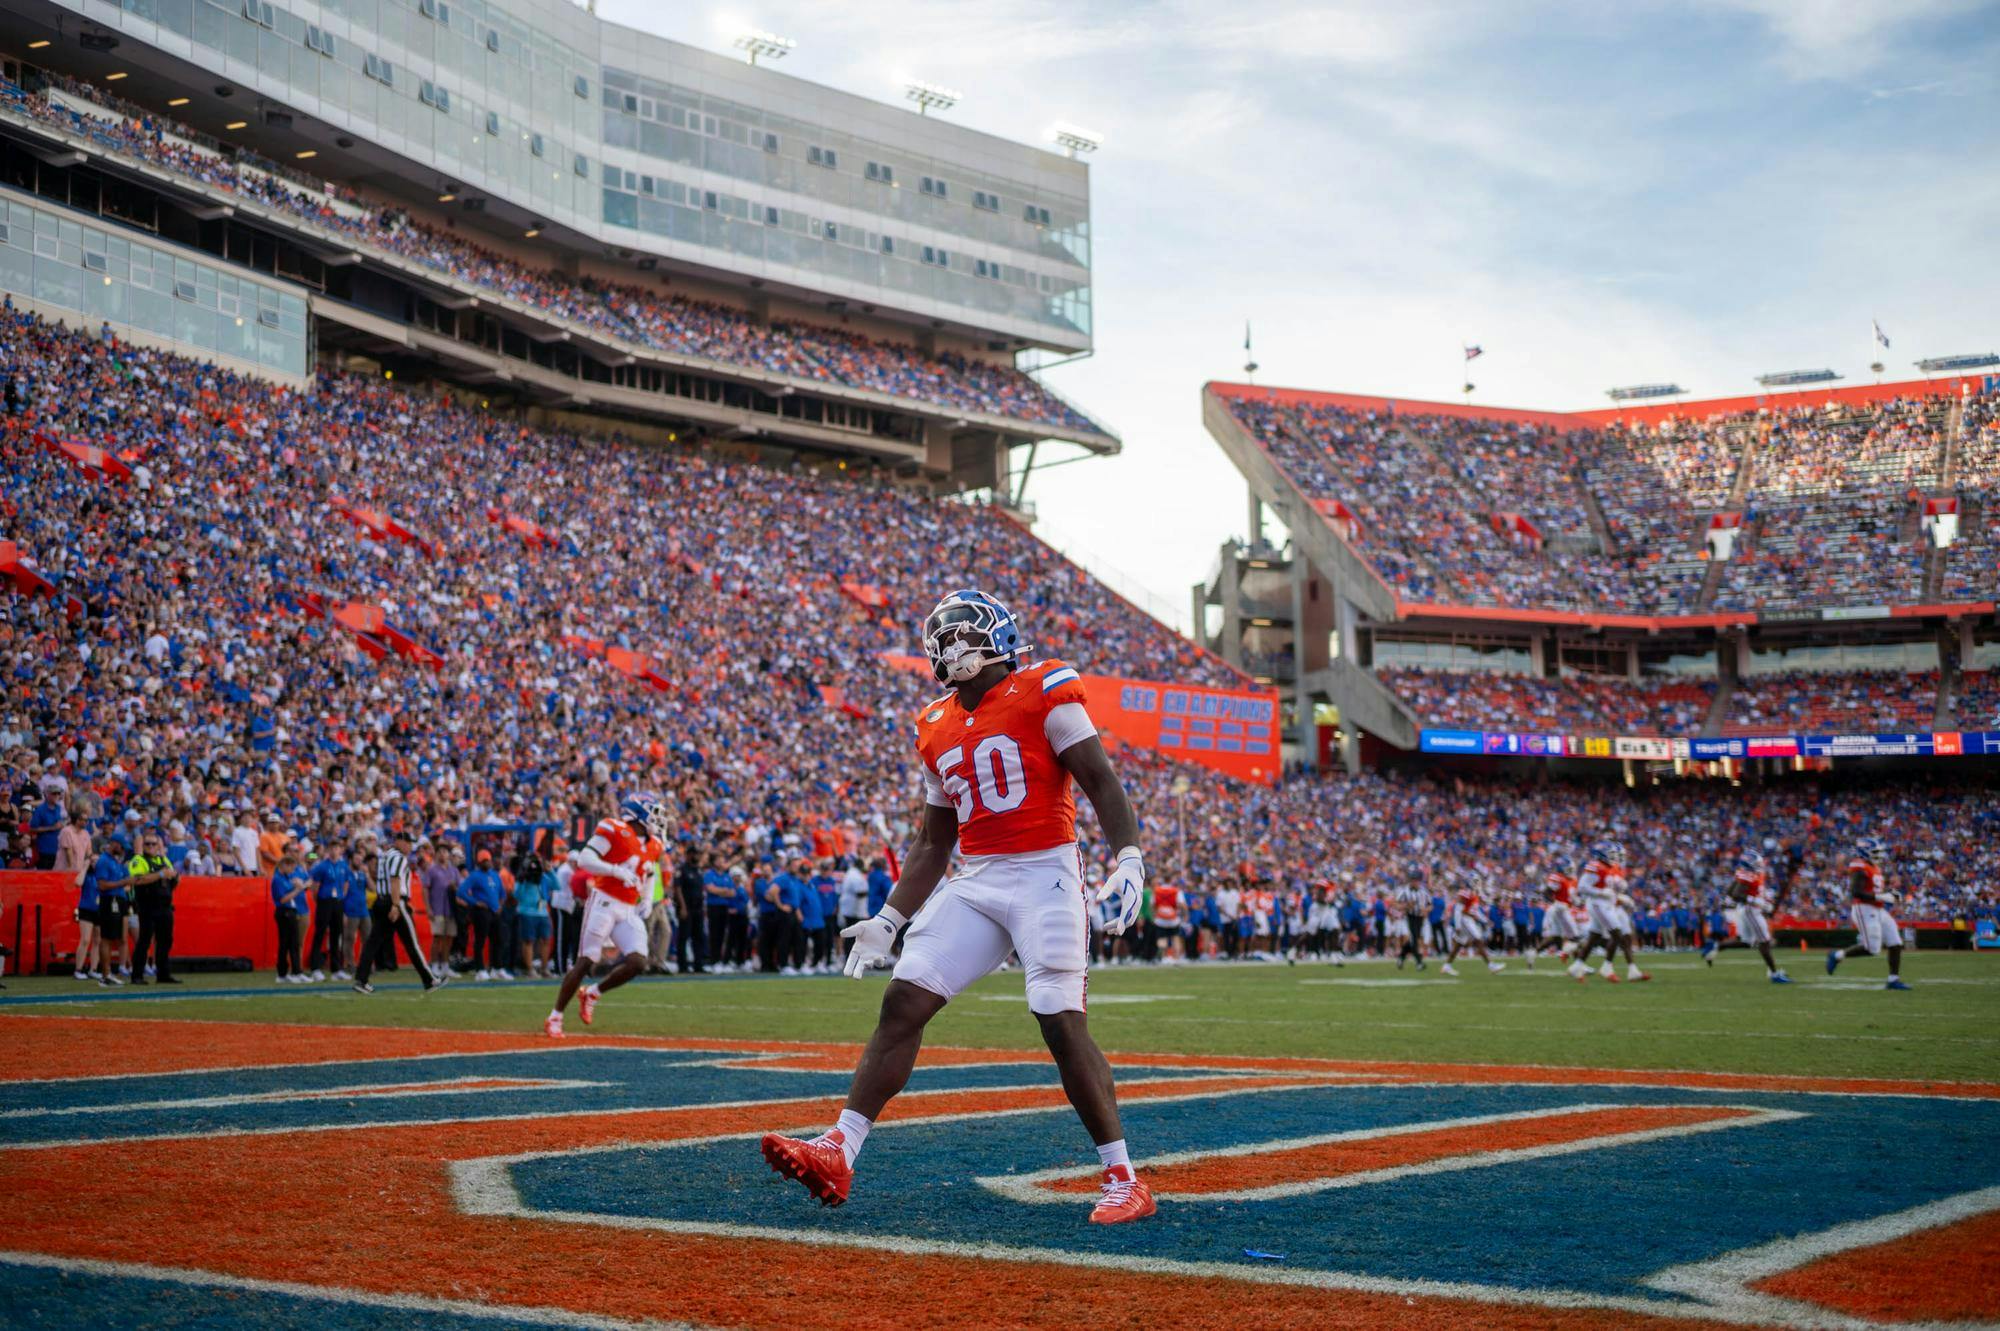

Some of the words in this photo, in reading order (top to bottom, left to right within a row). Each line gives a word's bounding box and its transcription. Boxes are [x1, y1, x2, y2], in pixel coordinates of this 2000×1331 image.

[1120, 685, 1157, 712] SEC
[1163, 690, 1274, 723] CHAMPIONS
[935, 733, 1029, 825] 50
